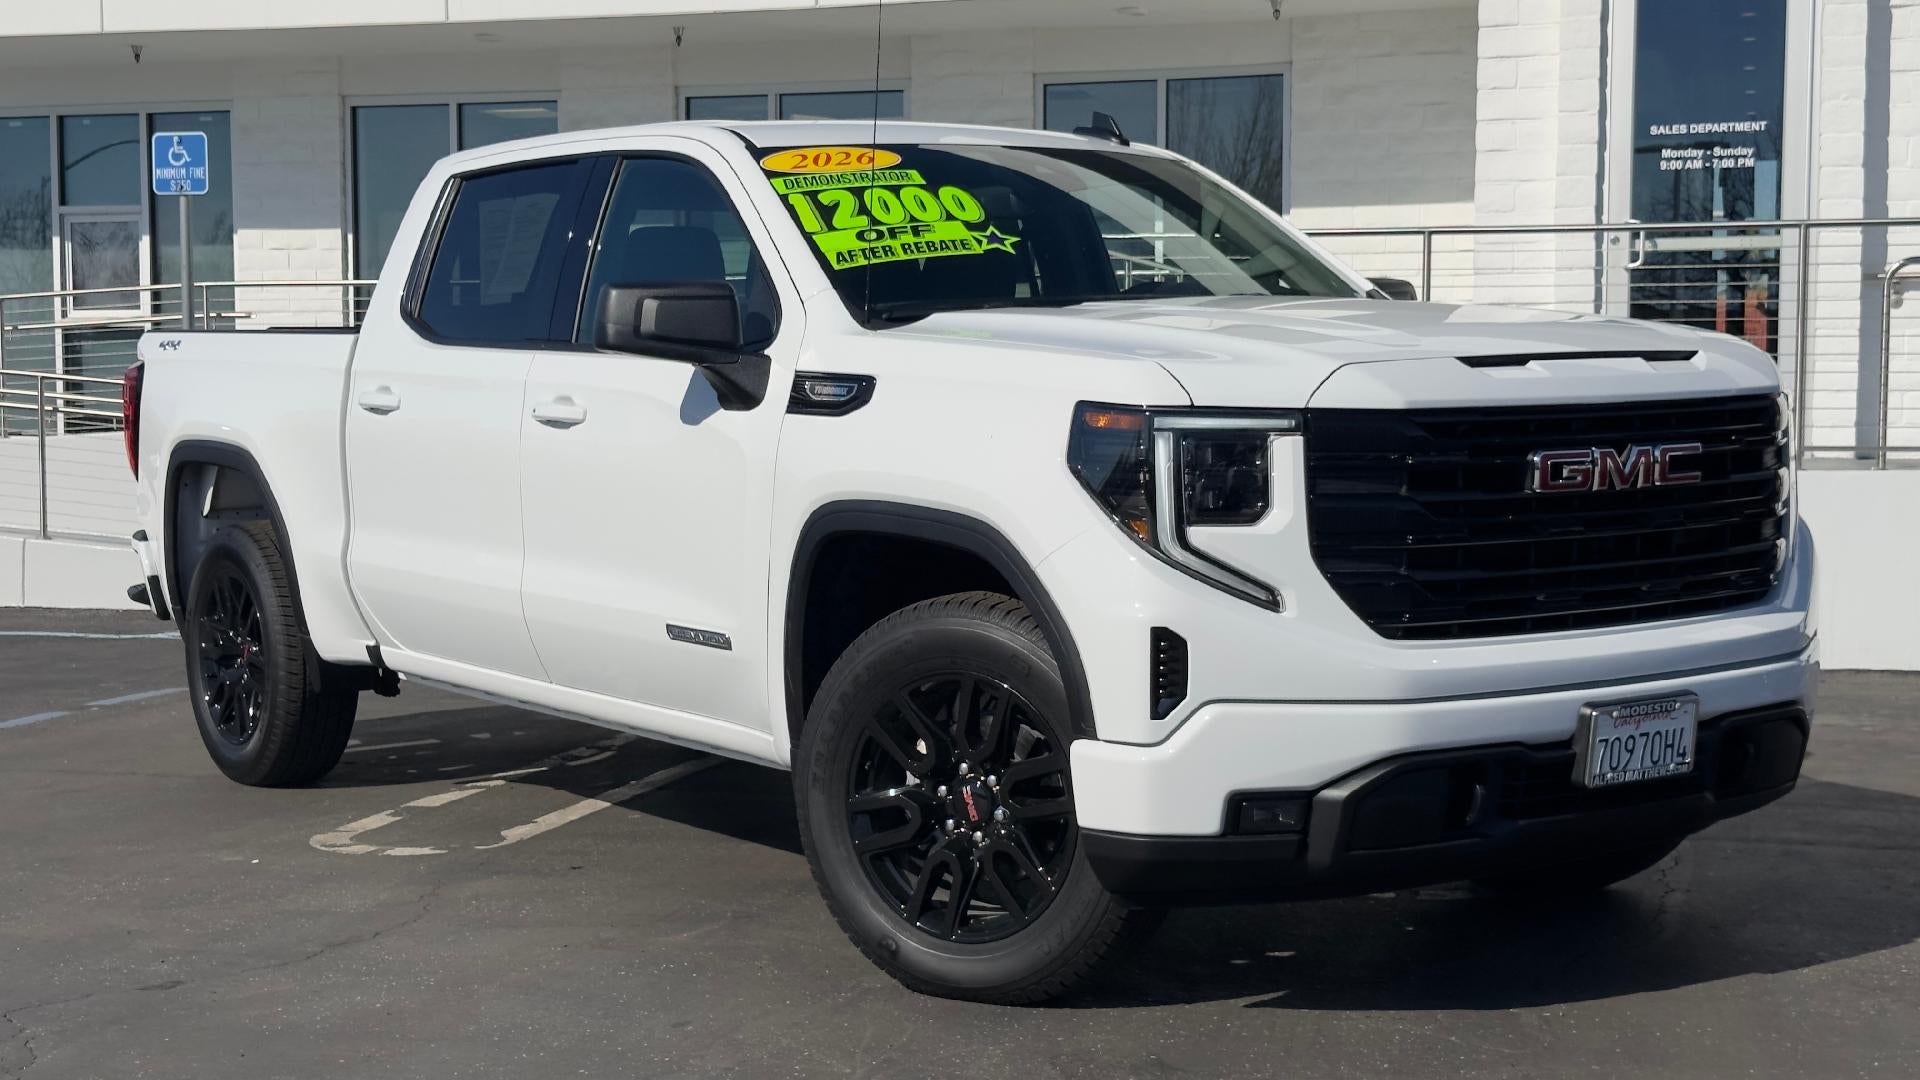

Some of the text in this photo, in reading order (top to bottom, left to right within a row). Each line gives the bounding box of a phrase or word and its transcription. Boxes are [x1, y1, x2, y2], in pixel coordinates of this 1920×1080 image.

[1650, 121, 1767, 135] SALES DEPARTMENT
[791, 151, 874, 169] 2026
[1661, 148, 1703, 159] Monday
[1712, 146, 1754, 158] Sunday
[156, 167, 205, 179] MINIMUM FINE
[1660, 160, 1682, 170] 9:00
[1684, 160, 1703, 169] AM
[1712, 159, 1734, 168] 7:00
[1737, 158, 1755, 167] PM
[783, 170, 911, 190] DEMONSTRATOR
[788, 186, 984, 234] 12000
[855, 224, 934, 243] OFF
[836, 239, 973, 266] AFTER REBATE
[1526, 443, 1702, 493] GMC
[1620, 702, 1675, 717] MODESTO
[1597, 727, 1687, 771] 70970H4
